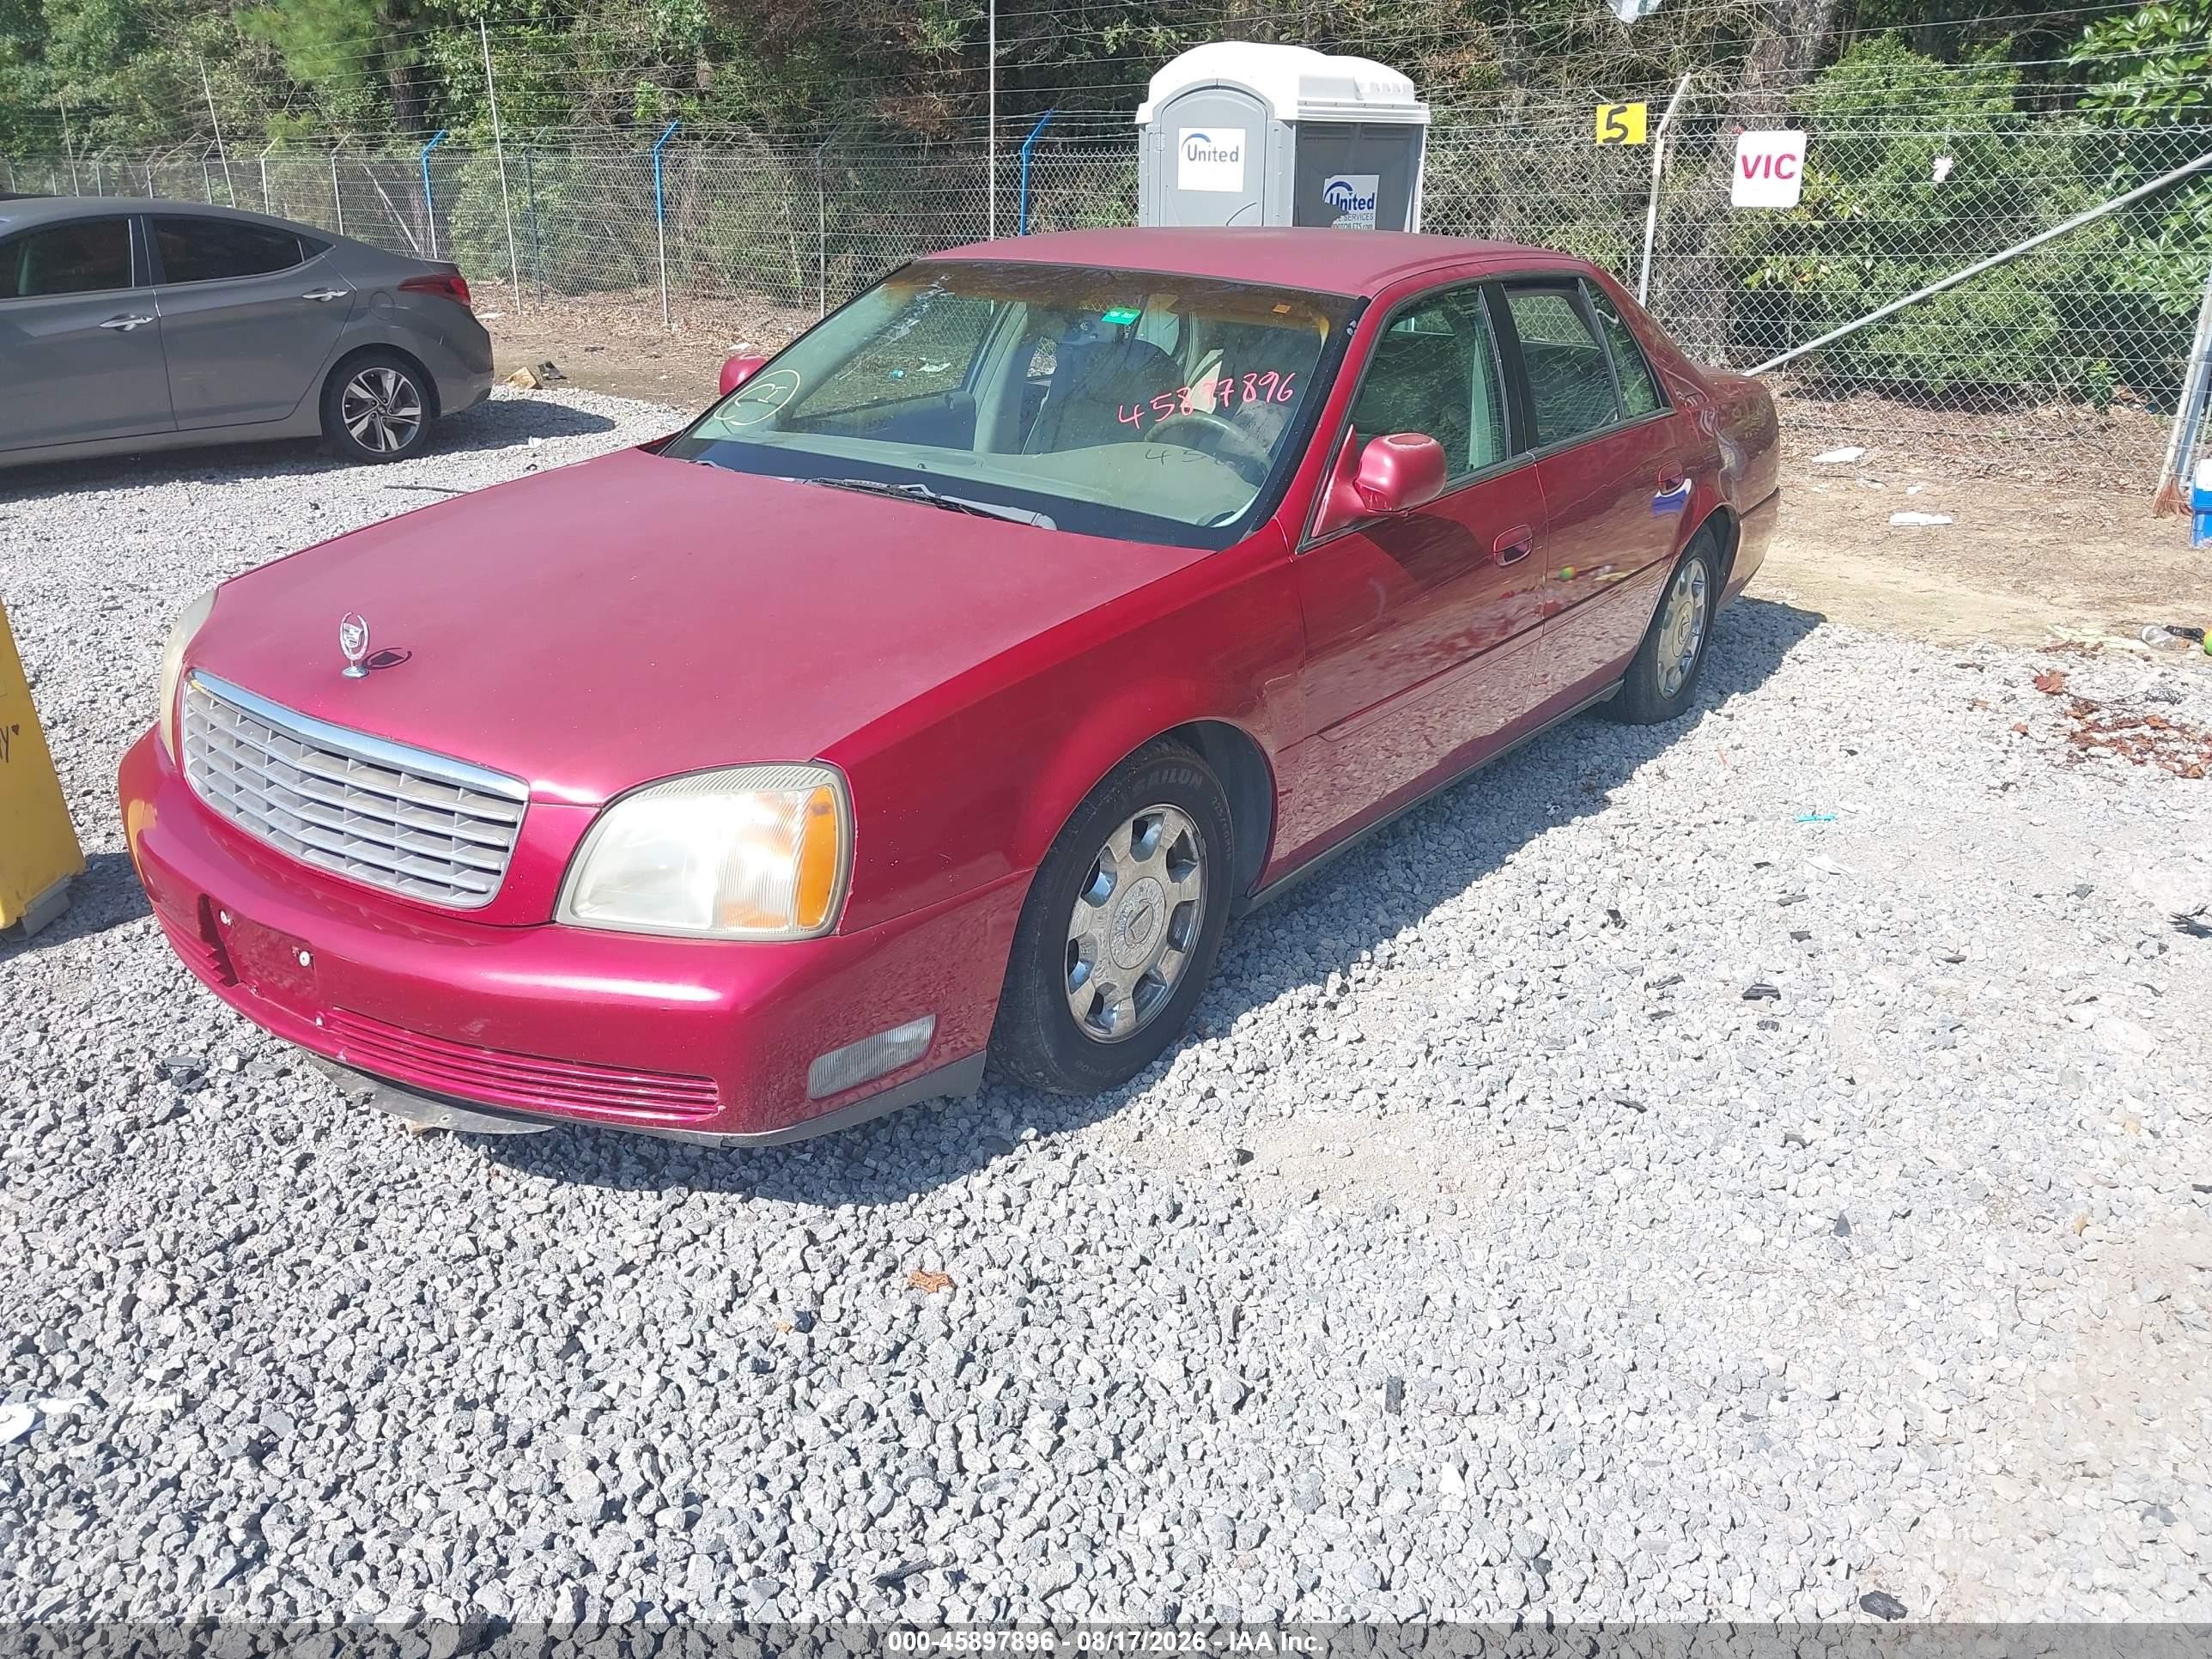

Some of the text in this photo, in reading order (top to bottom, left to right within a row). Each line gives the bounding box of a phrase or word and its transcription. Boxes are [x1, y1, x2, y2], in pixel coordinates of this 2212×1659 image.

[1602, 105, 1629, 143] 5
[1187, 143, 1239, 163] United
[1741, 153, 1797, 180] VIC
[1328, 191, 1376, 212] United
[1344, 212, 1374, 222] SERVICES
